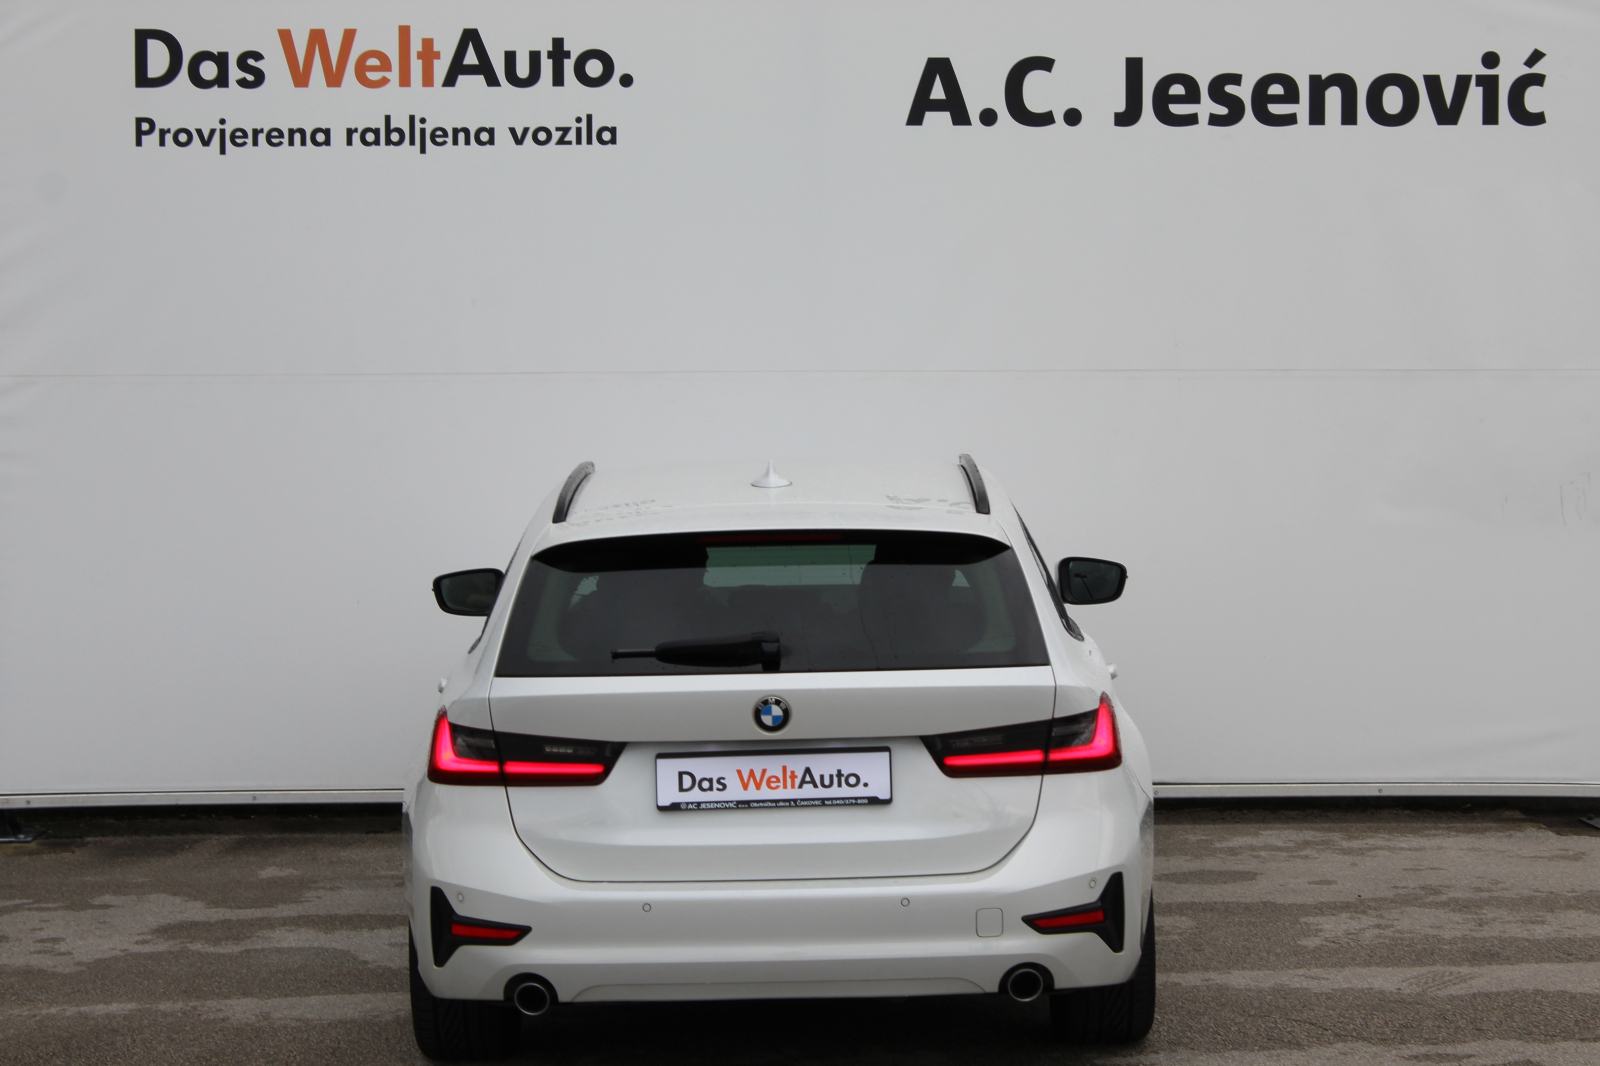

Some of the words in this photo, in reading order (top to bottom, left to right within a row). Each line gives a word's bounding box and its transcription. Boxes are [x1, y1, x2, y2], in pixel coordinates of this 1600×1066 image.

[134, 28, 266, 89] Das
[277, 25, 635, 89] WeltAuto.
[905, 56, 1083, 128] A.C.
[1113, 48, 1547, 128] Jesenović
[134, 116, 332, 155] Provjerena
[345, 114, 496, 155] rabljena
[508, 113, 618, 147] vozila
[677, 770, 728, 793] Das
[736, 765, 869, 792] WeltAuto.
